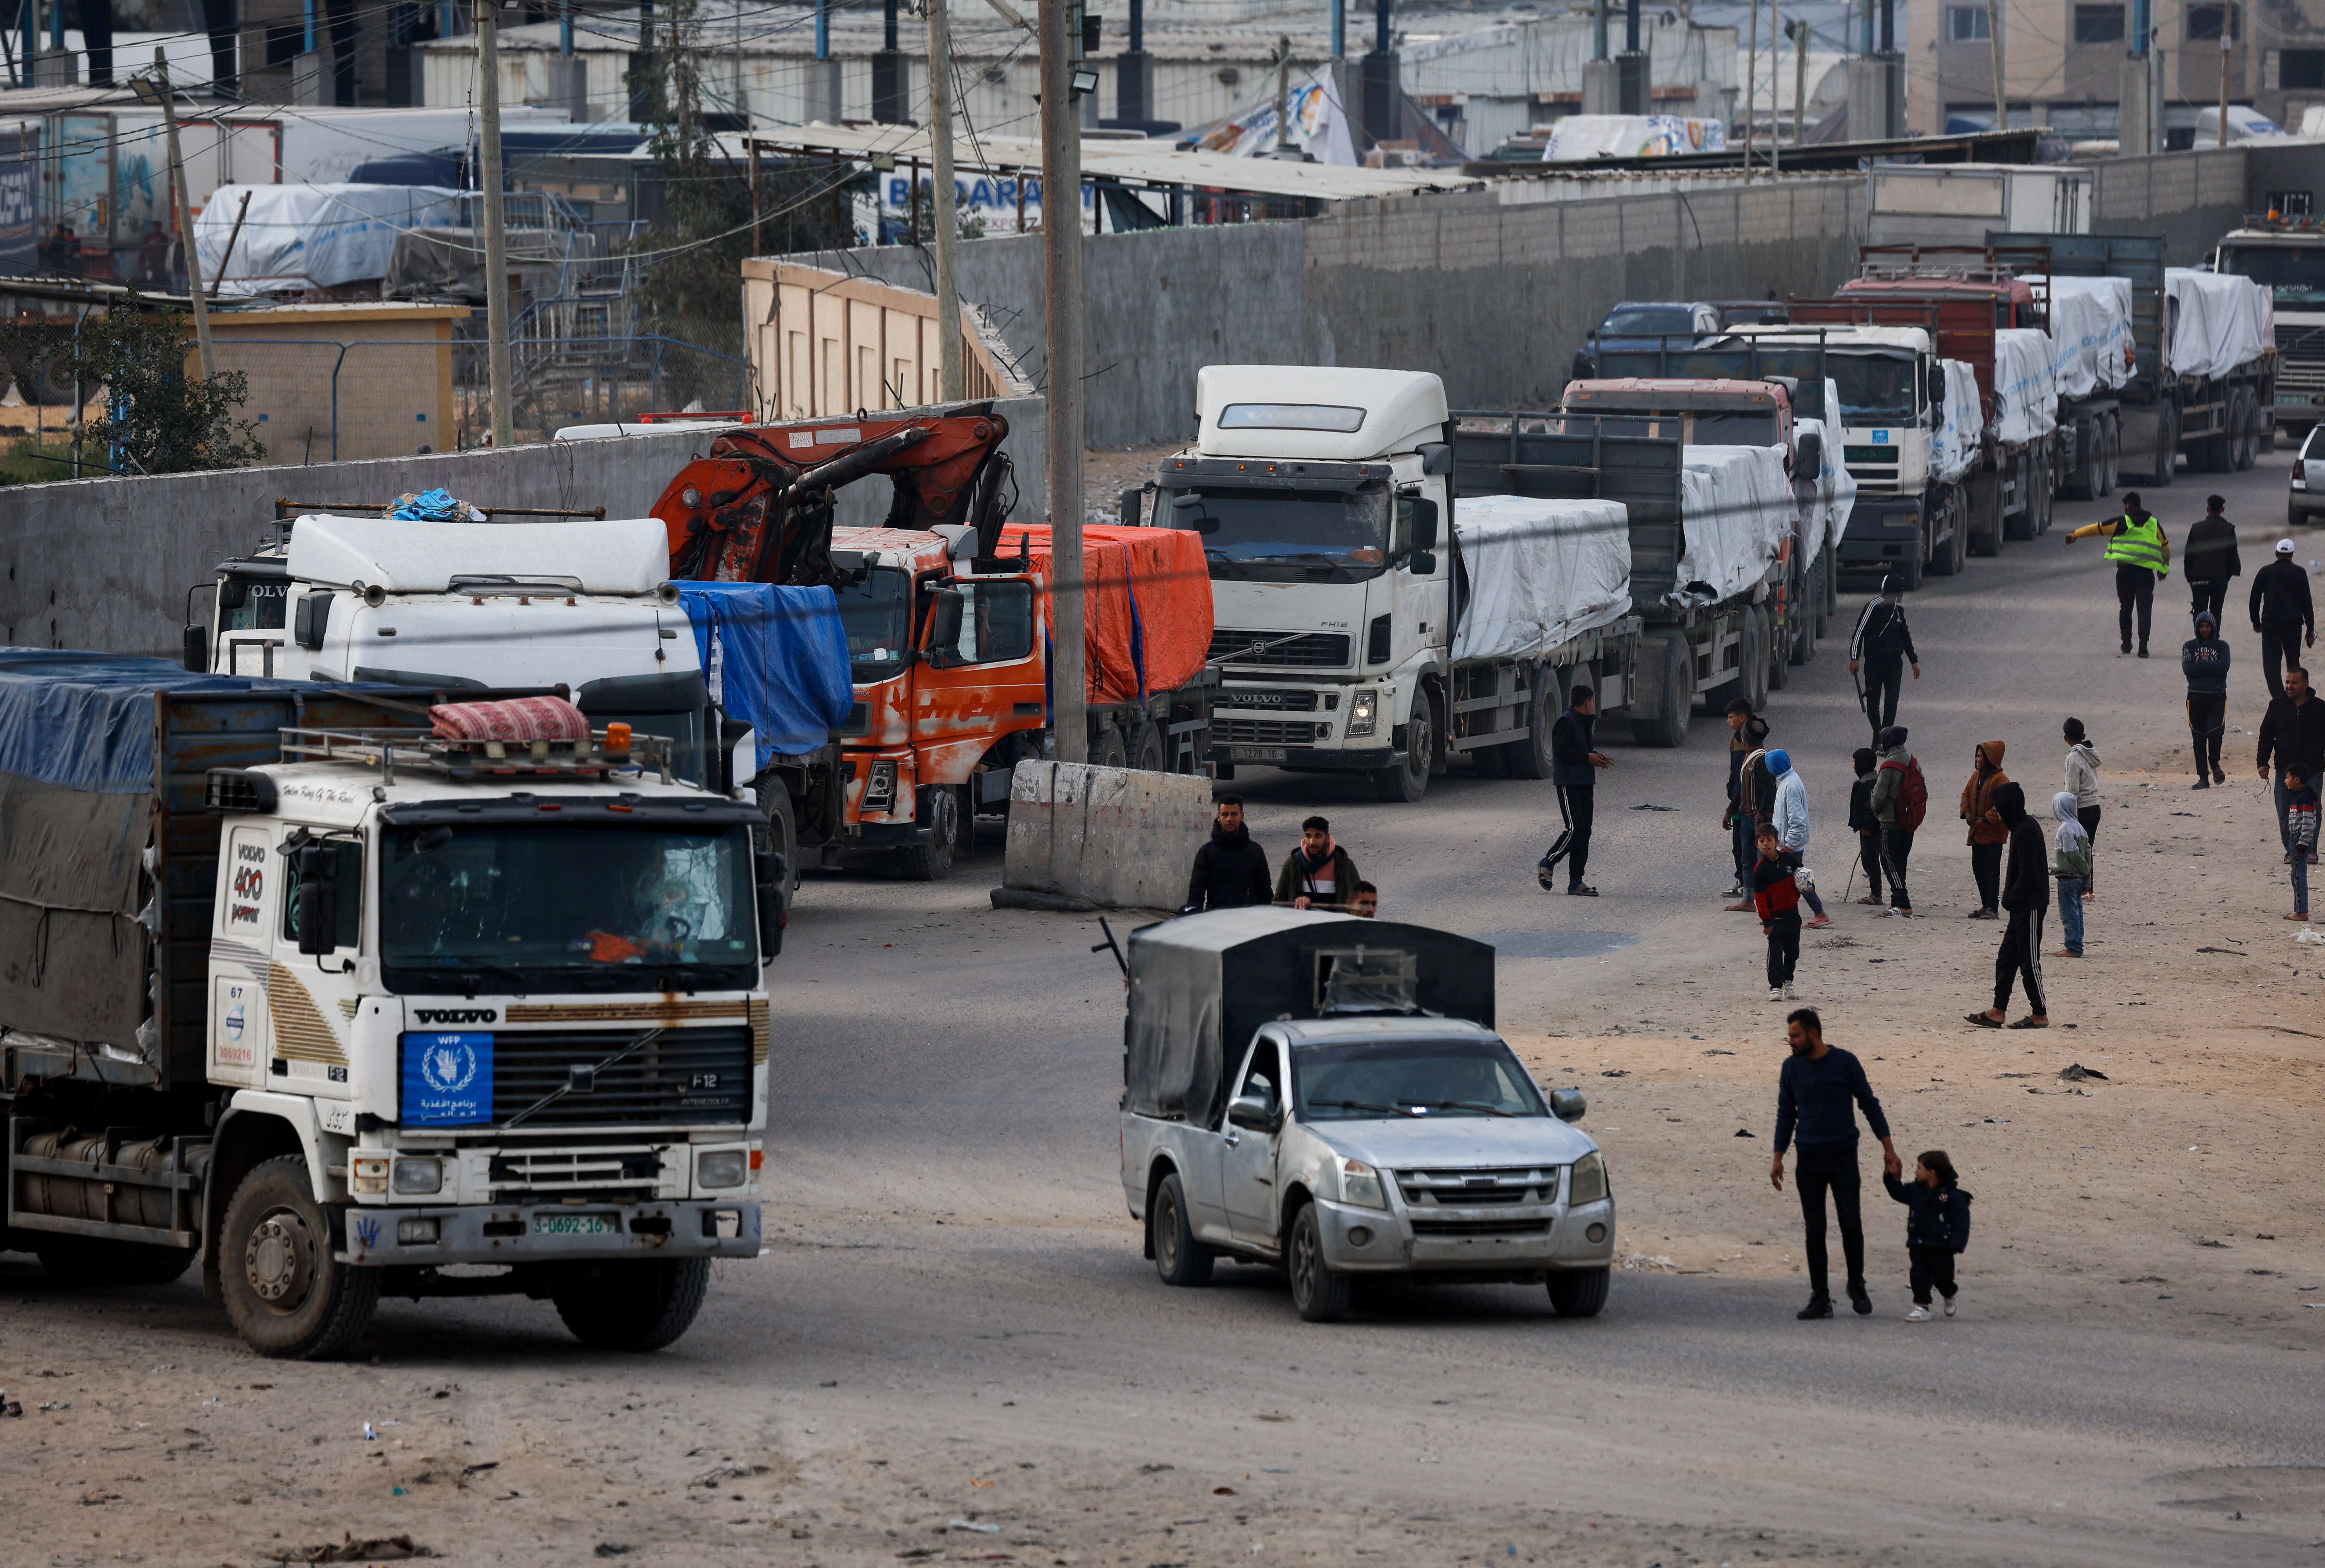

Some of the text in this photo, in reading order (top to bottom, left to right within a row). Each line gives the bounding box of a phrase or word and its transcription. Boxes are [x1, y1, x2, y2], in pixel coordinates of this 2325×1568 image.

[1845, 449, 1893, 459] DAF
[1230, 694, 1282, 703] VOLVO
[283, 784, 357, 803] Volvo King Of The Road
[238, 843, 265, 863] VOLVO
[234, 866, 263, 901] 400
[231, 904, 260, 925] power
[231, 987, 243, 999] 67
[227, 1019, 243, 1027] VOLVO
[414, 1009, 497, 1024] VOLVO
[437, 1036, 461, 1044] WFP
[292, 1064, 345, 1081] VOLVO F12
[693, 1074, 717, 1088] F12
[451, 1100, 476, 1111] برنامج
[534, 1217, 602, 1234] 3-0692-16
